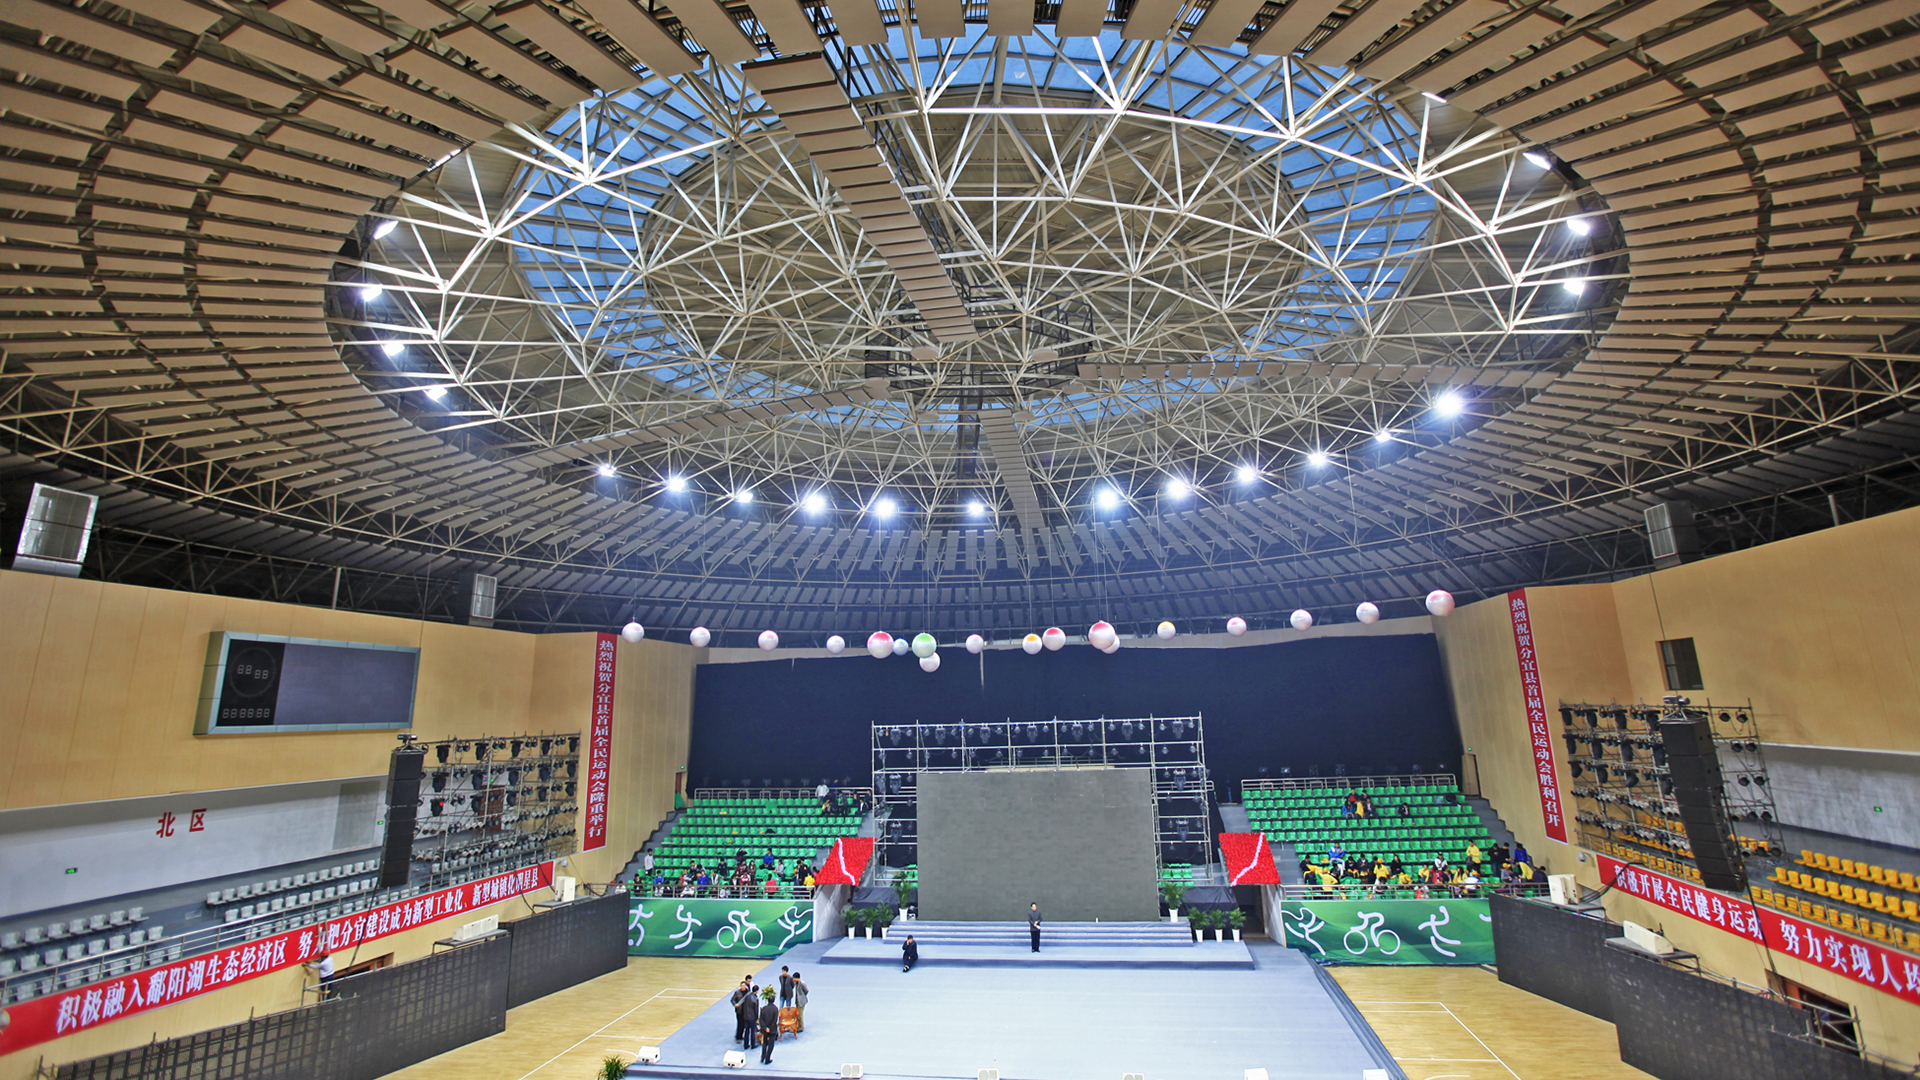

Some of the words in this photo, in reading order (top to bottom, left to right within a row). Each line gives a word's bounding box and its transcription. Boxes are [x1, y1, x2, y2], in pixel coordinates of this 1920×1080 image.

[588, 640, 615, 837] 热烈祝贺分宜县首届全民运动会隆重举行
[1511, 598, 1560, 827] 热烈祝贺分宜县首届全民运动会胜利召开
[56, 936, 289, 1034] 积极融入鄱阳湖生态经济区
